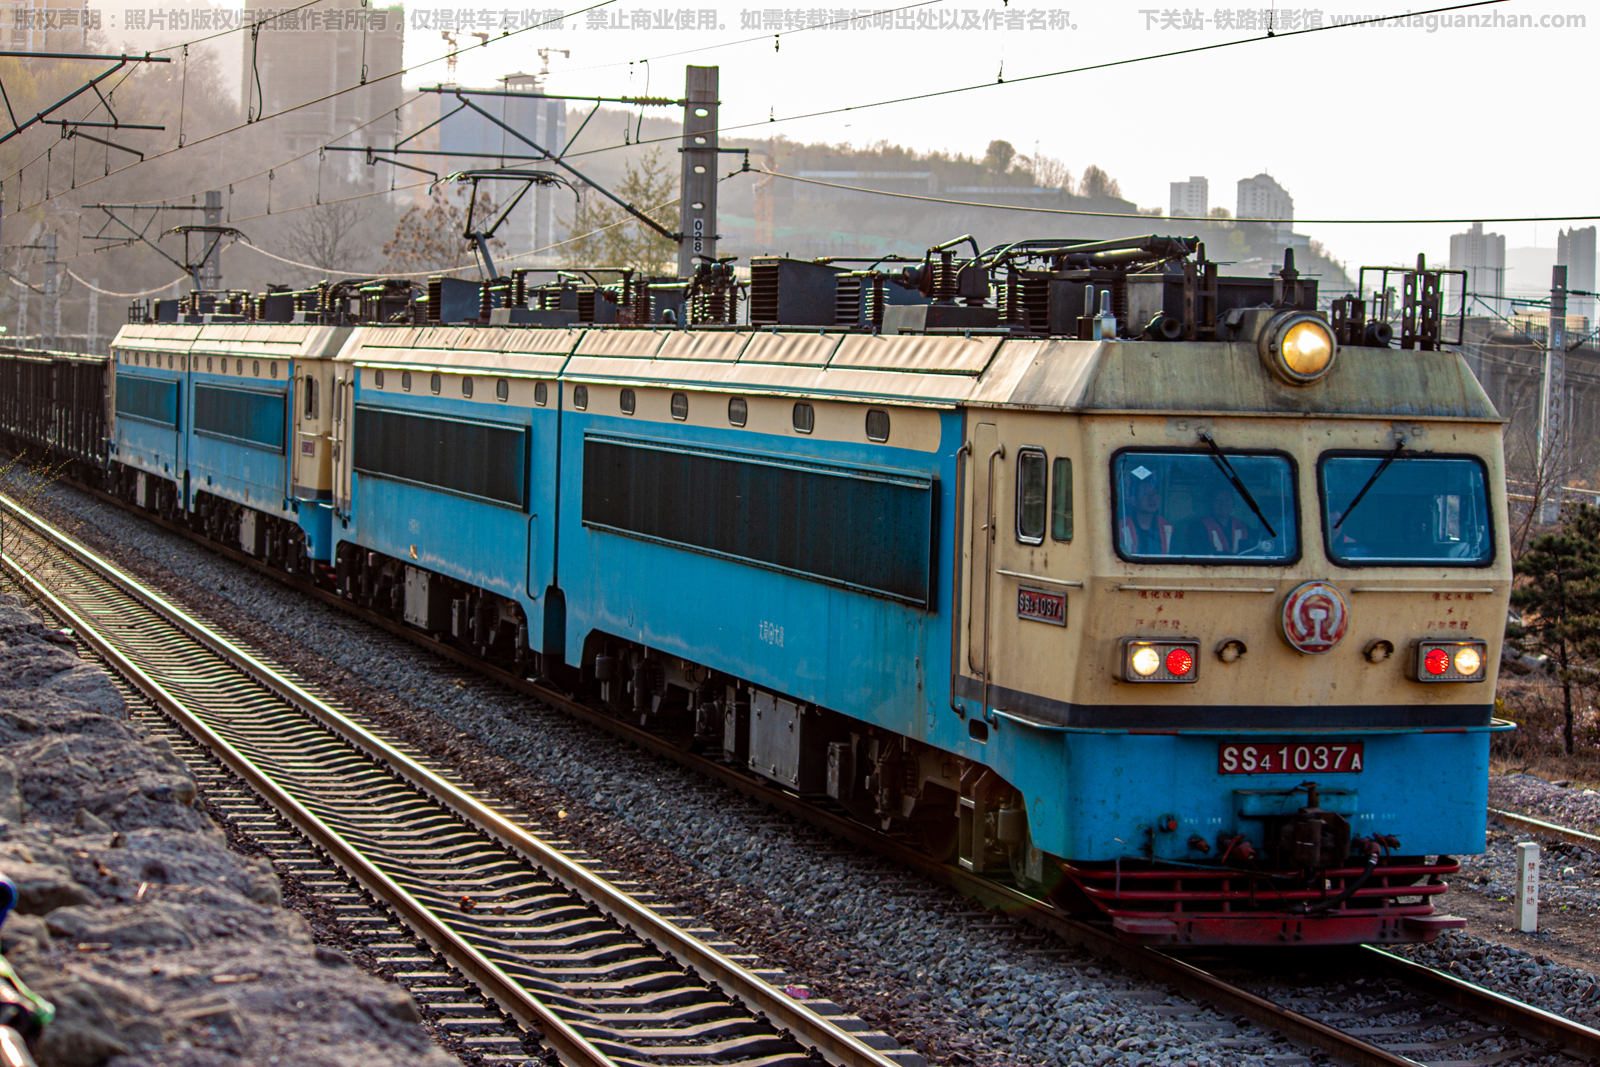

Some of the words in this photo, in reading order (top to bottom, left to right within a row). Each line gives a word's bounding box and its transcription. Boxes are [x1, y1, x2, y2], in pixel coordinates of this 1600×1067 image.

[694, 219, 703, 252] 028
[1277, 745, 1362, 771] 1037A
[1525, 861, 1536, 906] 禁止移动
